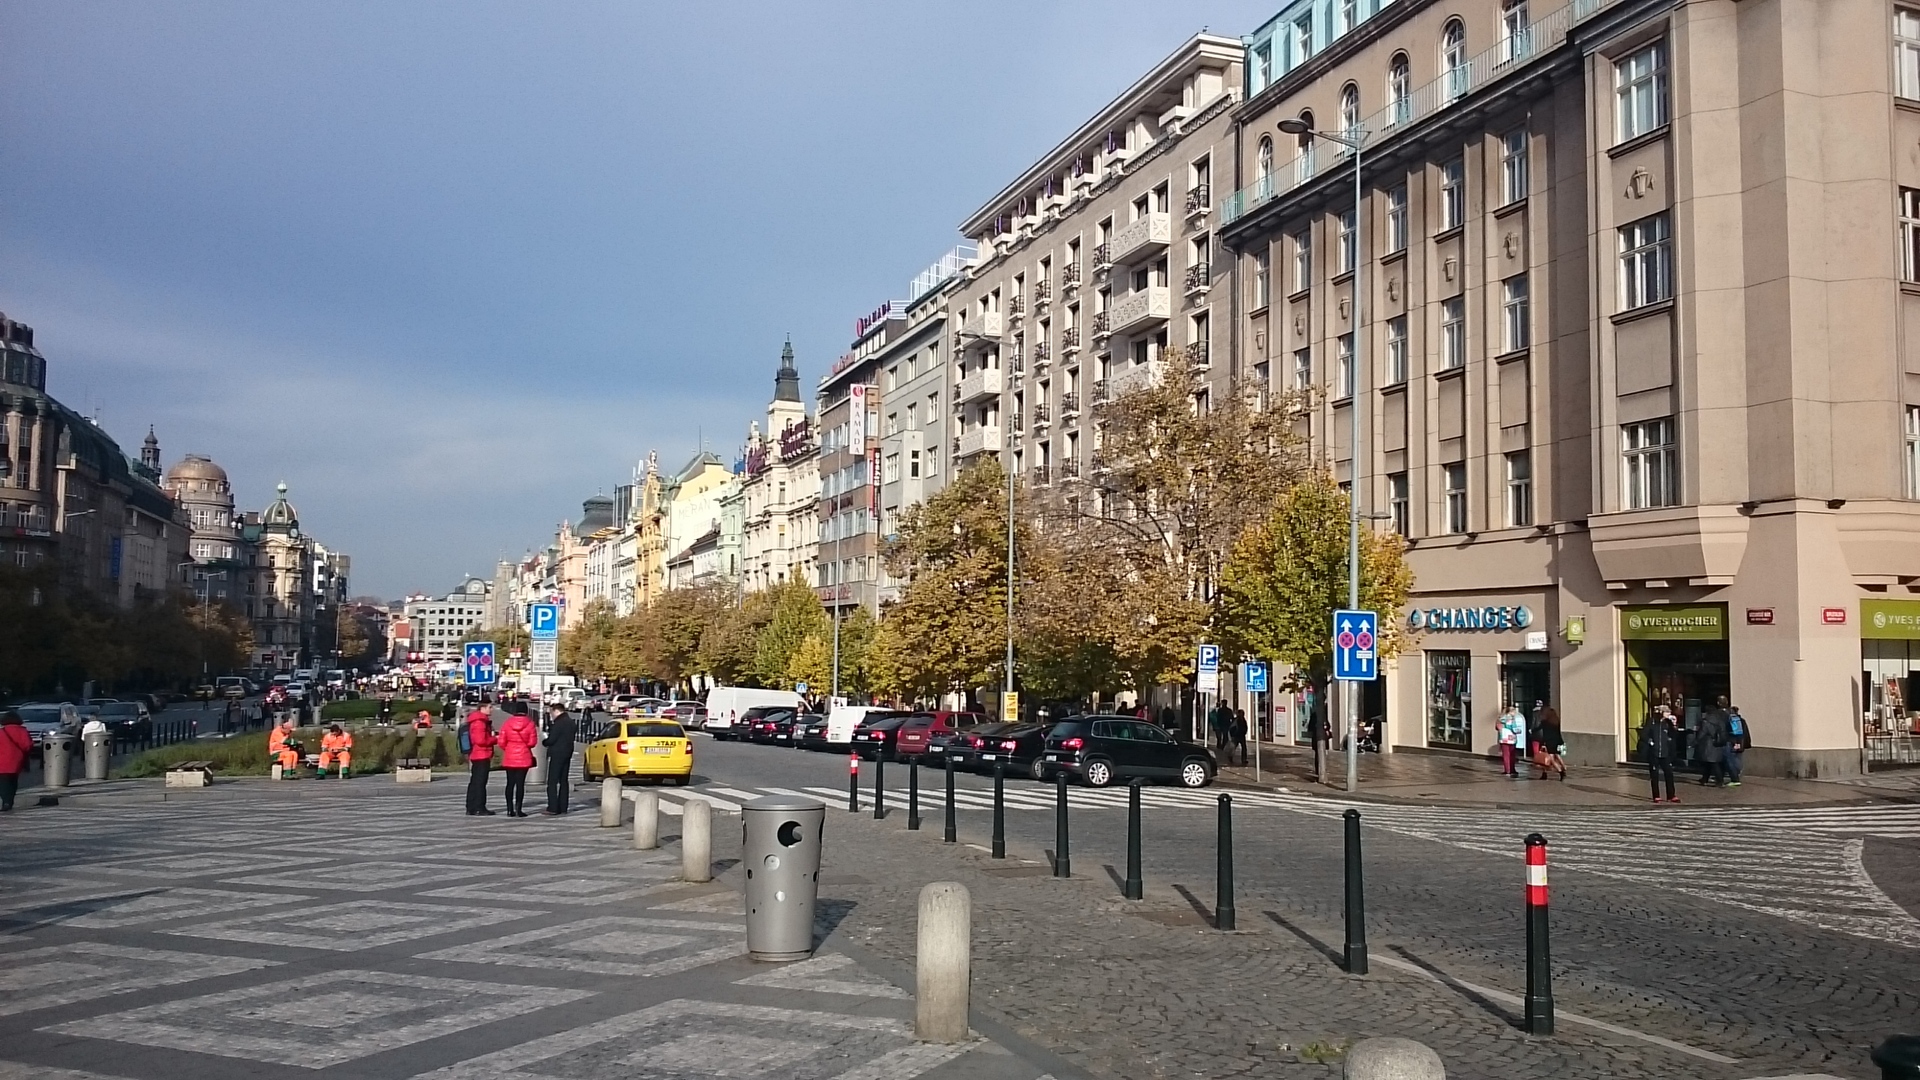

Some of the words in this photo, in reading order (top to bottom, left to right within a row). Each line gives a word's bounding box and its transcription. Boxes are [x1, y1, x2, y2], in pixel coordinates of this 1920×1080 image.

[864, 300, 891, 330] RAMADA
[679, 498, 711, 519] MERAN
[537, 608, 553, 628] P
[1428, 606, 1512, 629] CHANGE
[1642, 617, 1669, 626] YVES
[1671, 616, 1718, 626] ROCHER
[1888, 615, 1913, 625] YVES
[1202, 648, 1215, 664] P
[1249, 665, 1262, 682] P
